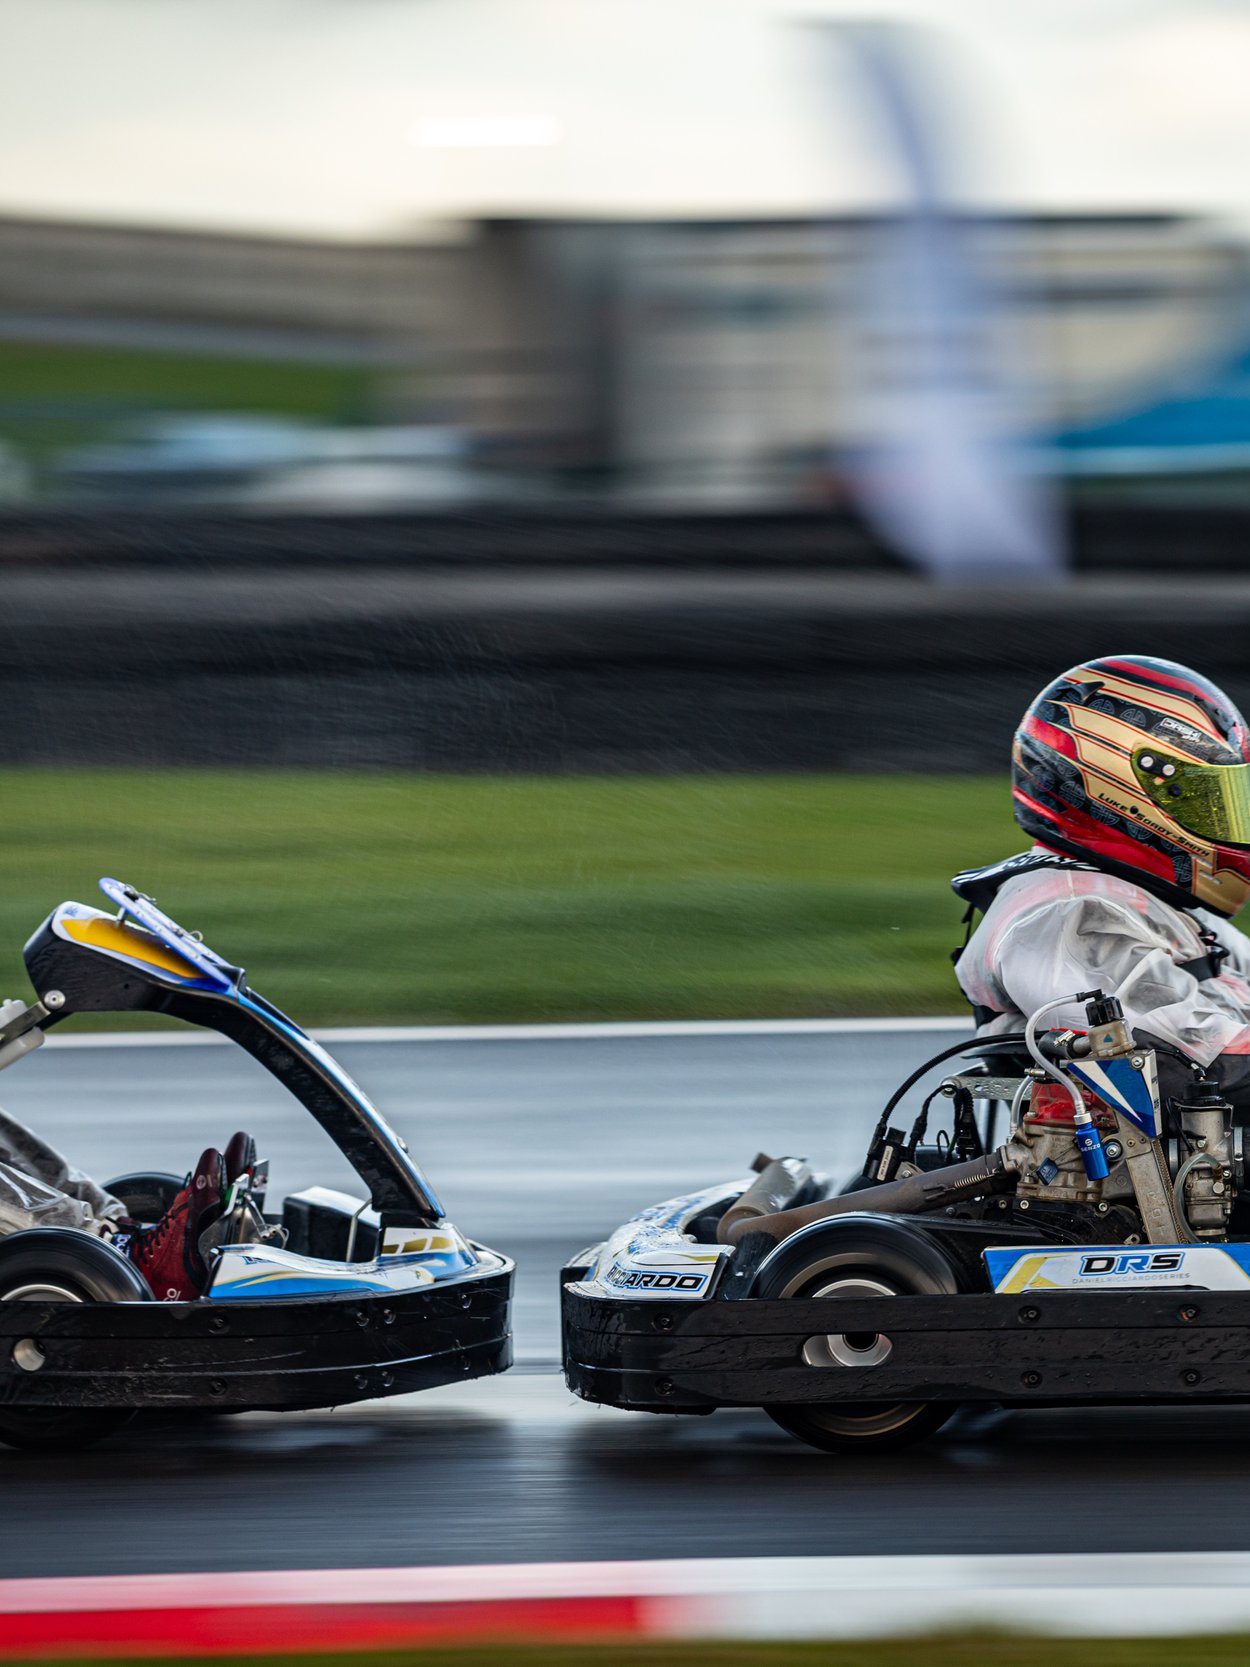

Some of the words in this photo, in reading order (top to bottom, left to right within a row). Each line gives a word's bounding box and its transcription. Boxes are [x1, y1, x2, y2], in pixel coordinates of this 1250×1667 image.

[1098, 793, 1129, 812] LUKE
[1081, 1253, 1183, 1275] DRS
[605, 1264, 706, 1290] RICCIARDO
